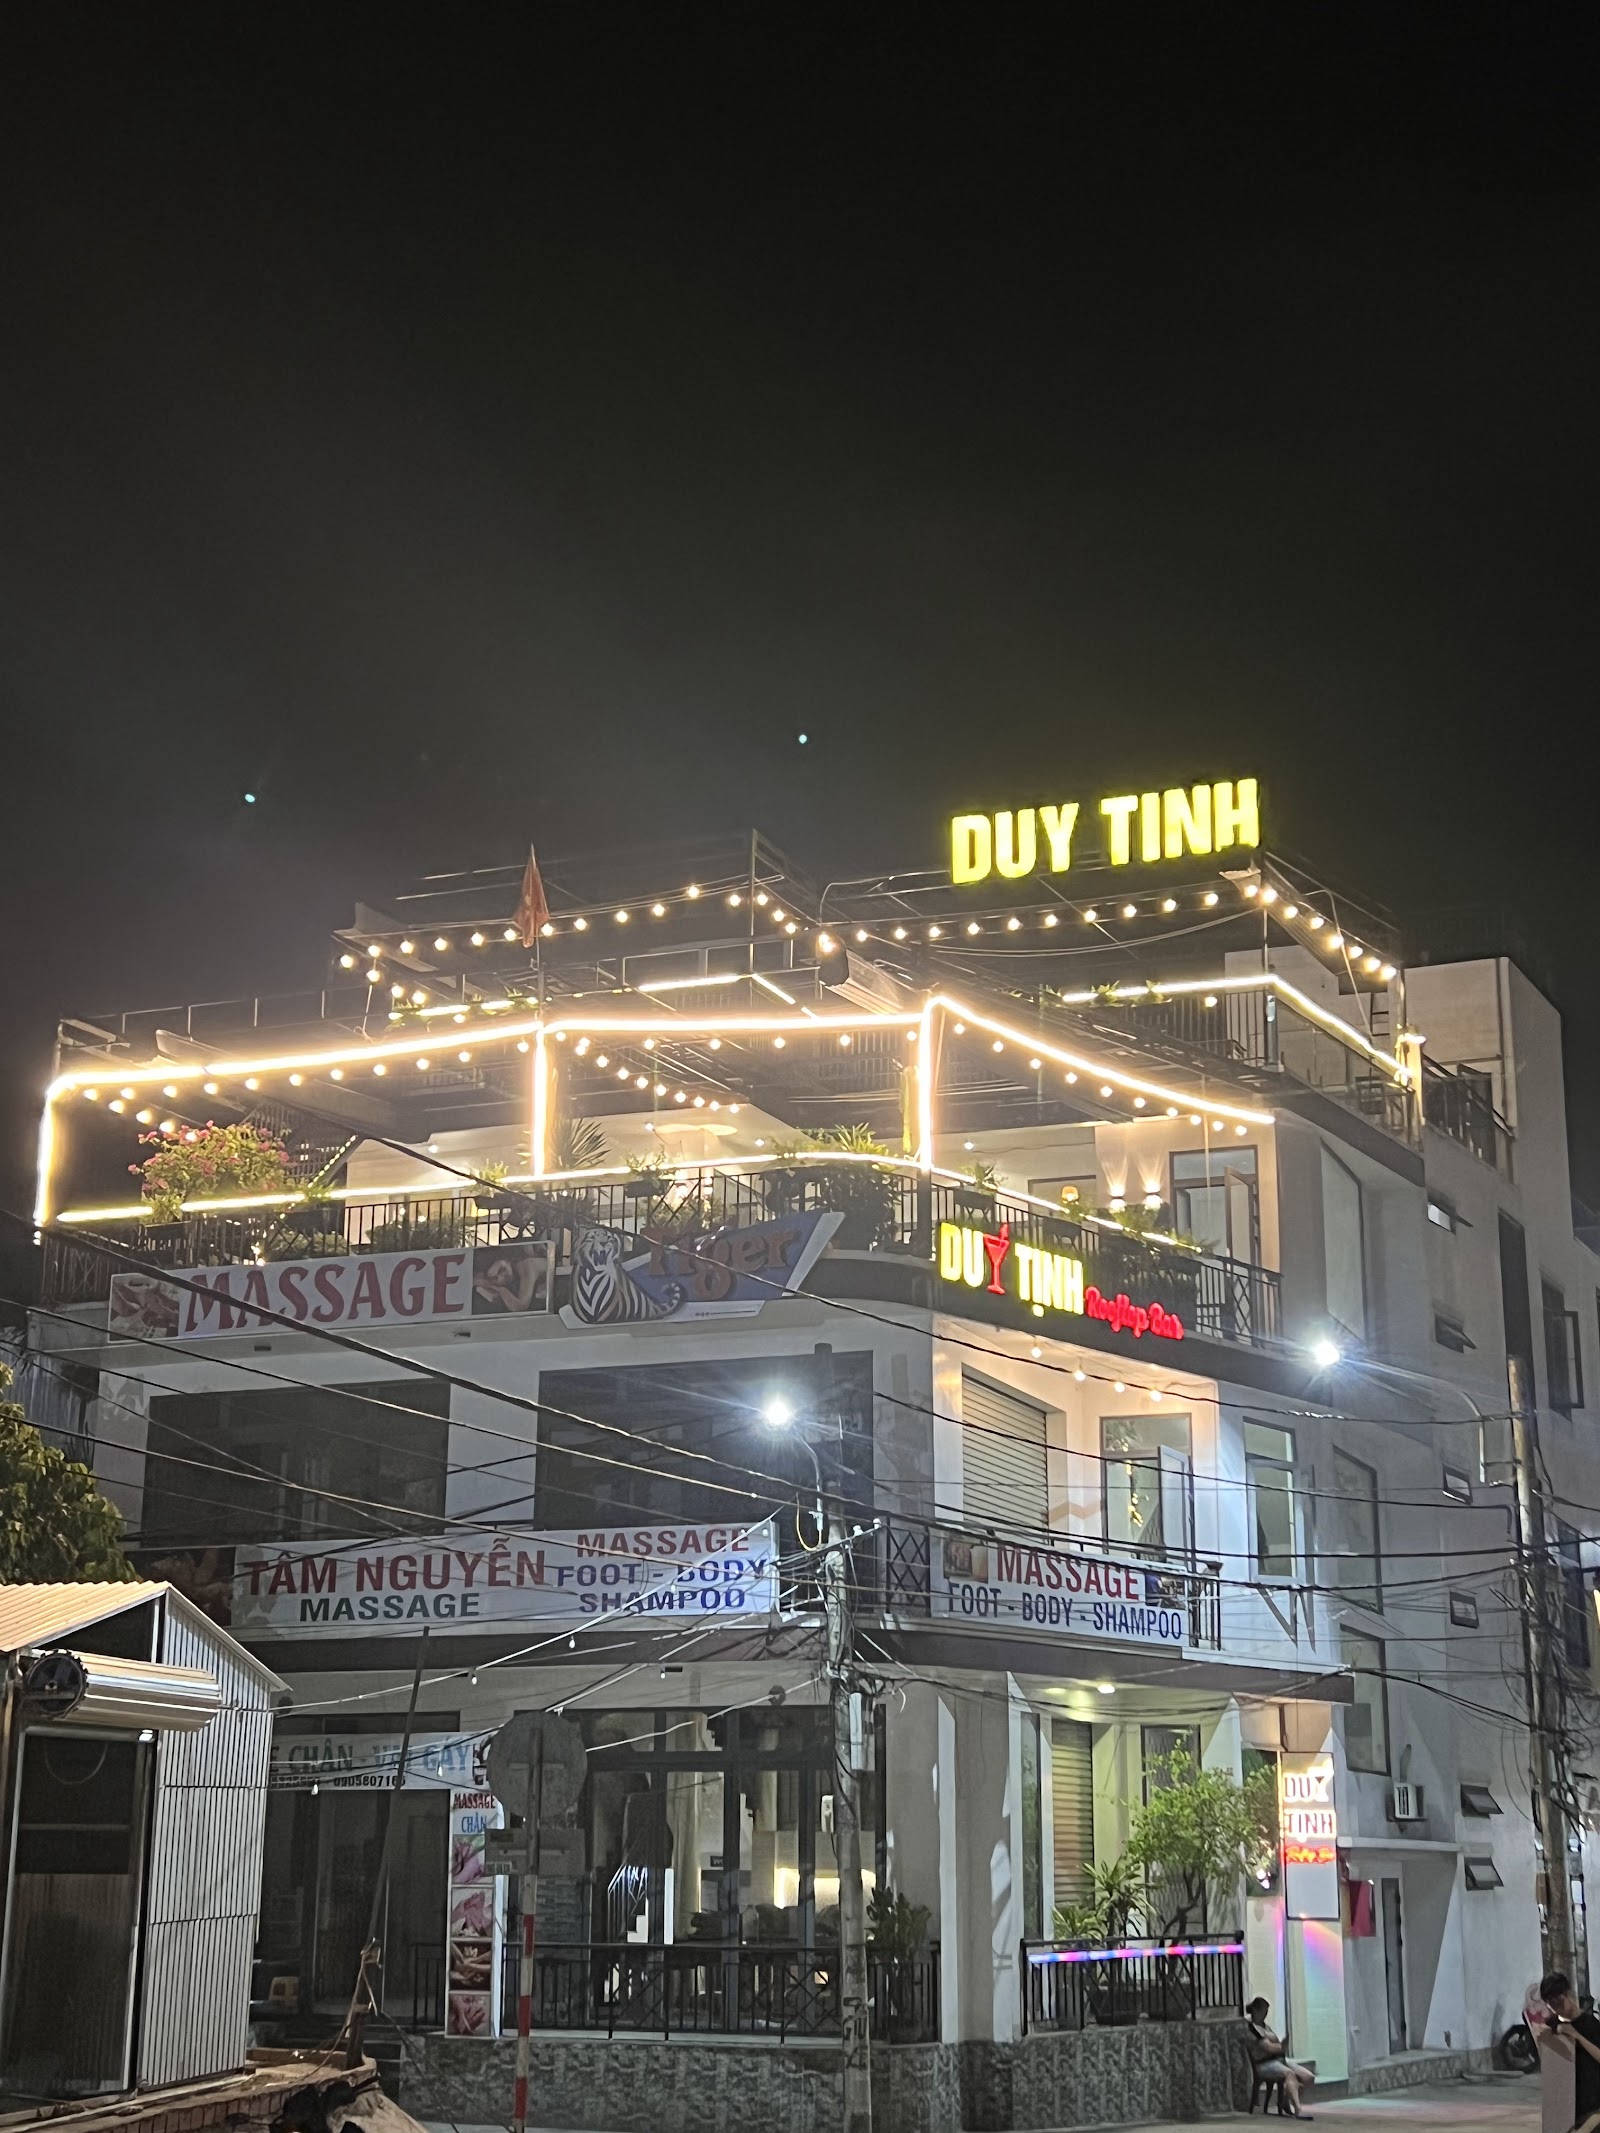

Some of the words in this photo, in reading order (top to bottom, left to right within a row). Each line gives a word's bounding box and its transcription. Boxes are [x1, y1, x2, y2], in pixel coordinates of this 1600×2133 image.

[952, 802, 1079, 884] DUY
[1100, 778, 1259, 866] TINH
[640, 1226, 799, 1300] Tiger
[940, 1222, 1010, 1295] DUY
[1014, 1243, 1084, 1318] TỊNH
[184, 1254, 465, 1333] MASSAGE
[244, 1550, 337, 1596] TÂM
[356, 1537, 546, 1592] NGUYỄN
[577, 1528, 750, 1558] MASSAGE
[557, 1563, 642, 1587] FOOT
[677, 1558, 767, 1583] BODY
[579, 1588, 745, 1613] SHAMPOO
[997, 1544, 1140, 1601] MASSAGE
[300, 1593, 480, 1622] MASSAGE
[949, 1582, 1001, 1618] FOOT
[1021, 1592, 1073, 1627] BODY
[1093, 1602, 1182, 1640] SHAMPOO
[454, 1793, 496, 1809] MASSAGE
